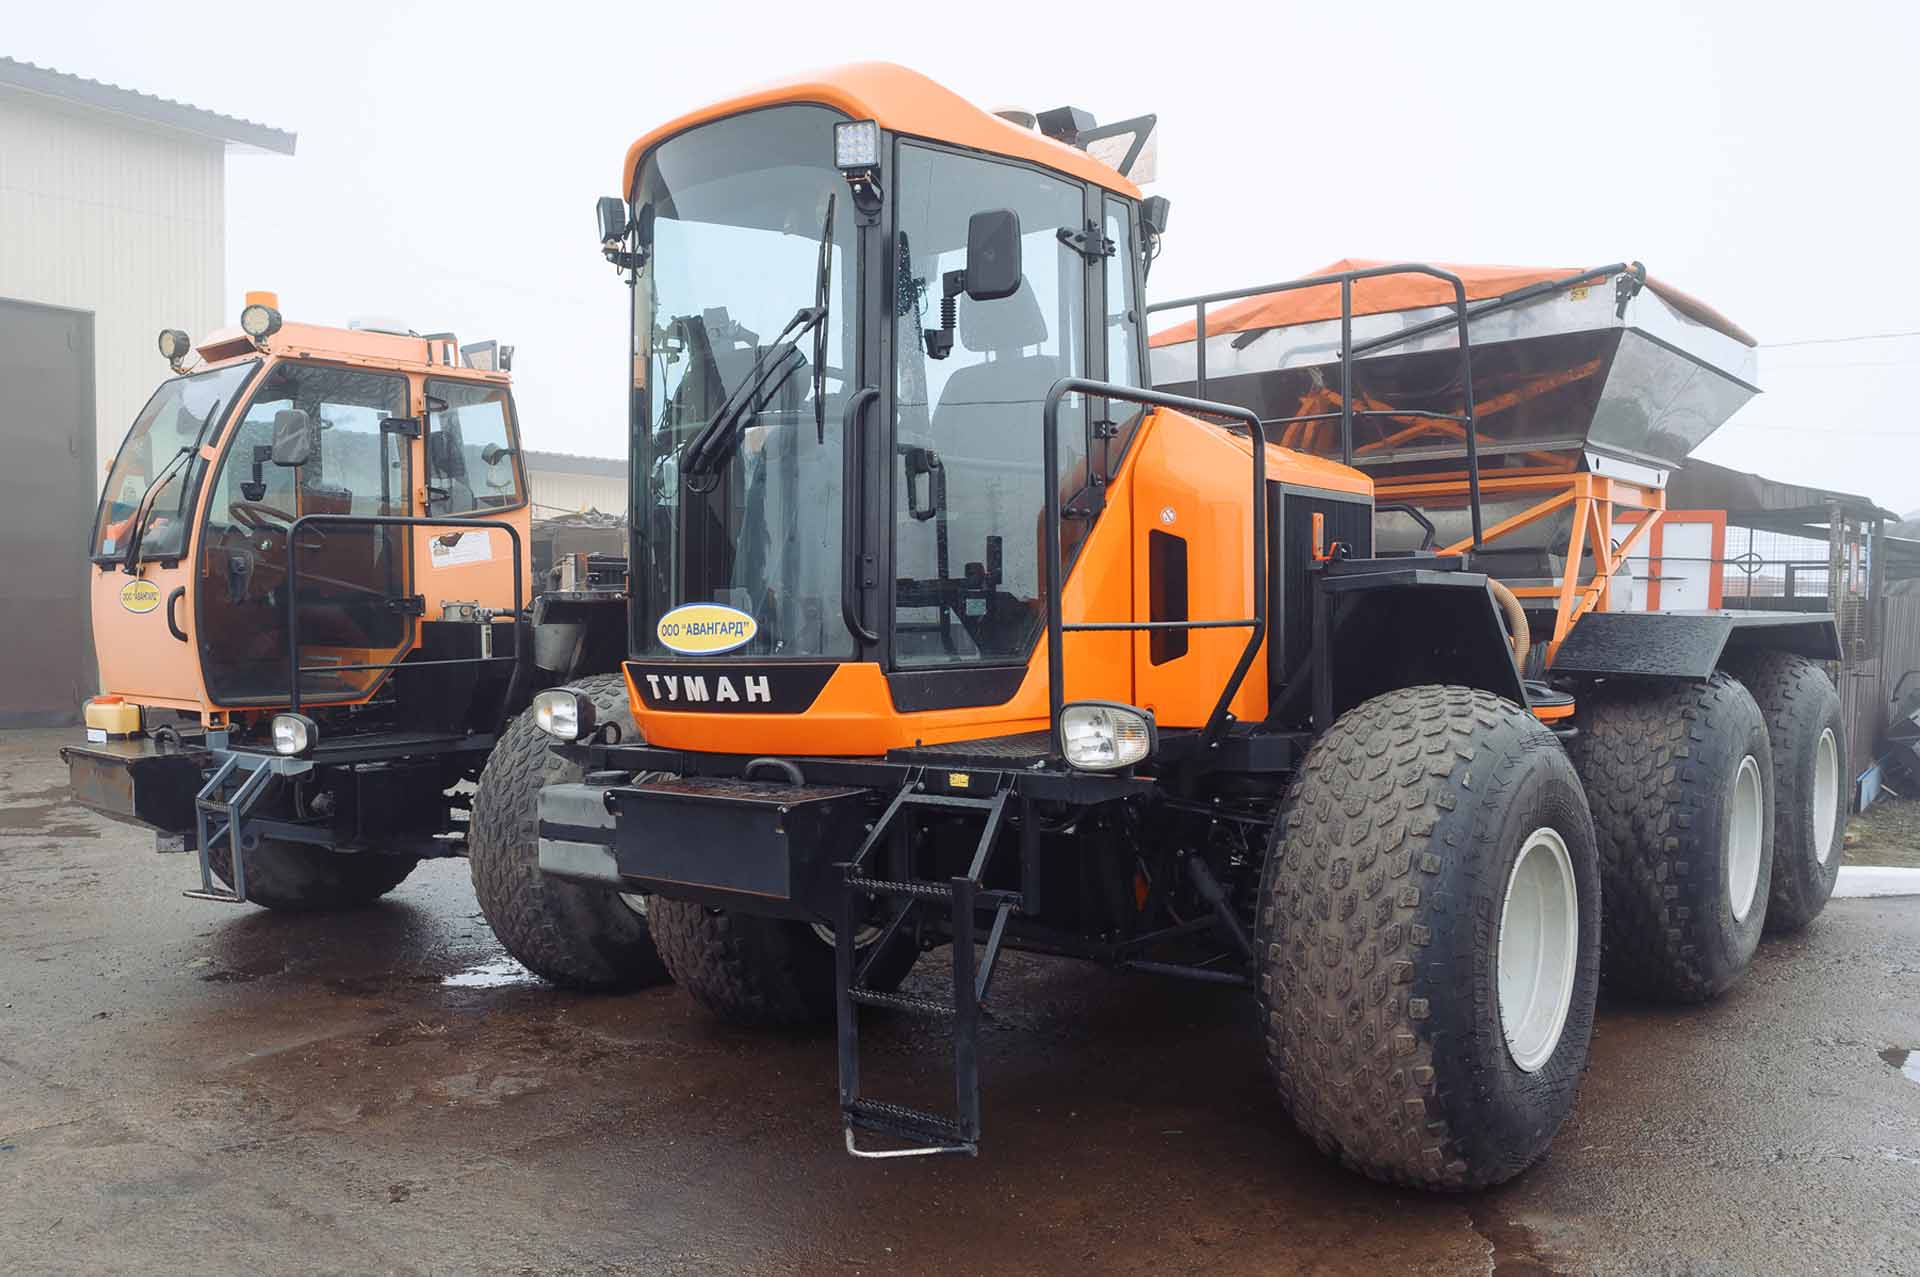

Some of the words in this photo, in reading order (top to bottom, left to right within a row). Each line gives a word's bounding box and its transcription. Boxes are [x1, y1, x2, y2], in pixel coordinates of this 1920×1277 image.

[661, 624, 680, 637] ООО
[681, 621, 749, 637] "АВАНГАРД"
[646, 674, 772, 702] ТУМАН
